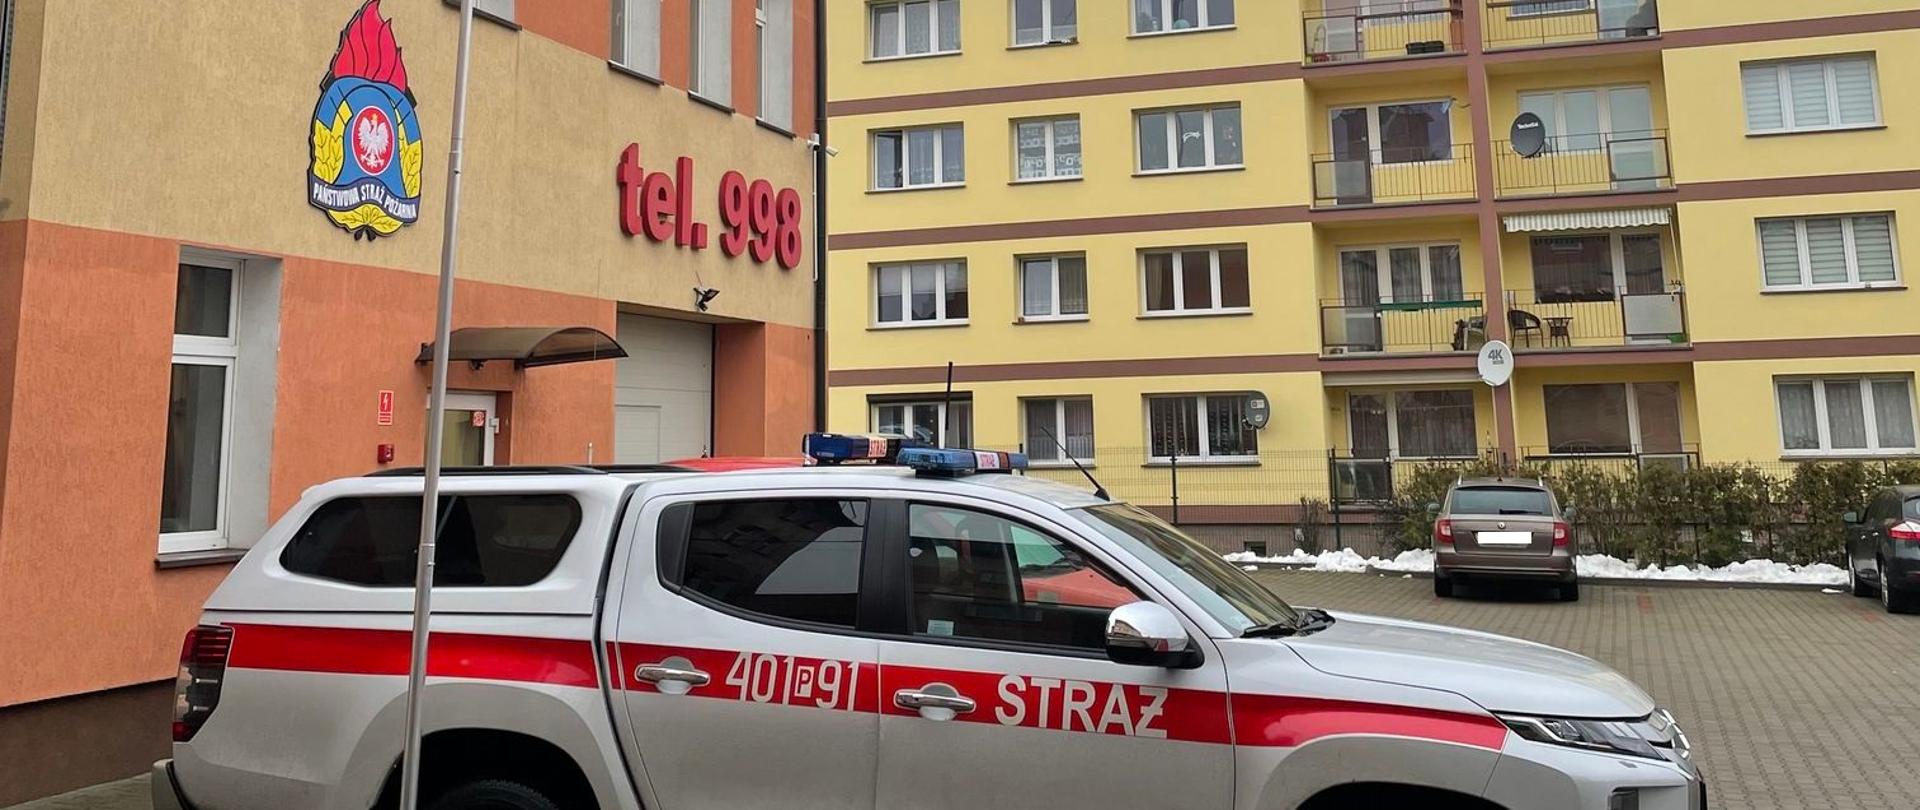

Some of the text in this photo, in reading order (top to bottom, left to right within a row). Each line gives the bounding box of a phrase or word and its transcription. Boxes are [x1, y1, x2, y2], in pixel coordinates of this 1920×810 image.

[313, 182, 417, 219] PAŃSTWOWA STRAŻ POŻARNA
[617, 142, 802, 269] tel. 998
[1488, 349, 1503, 360] 4K
